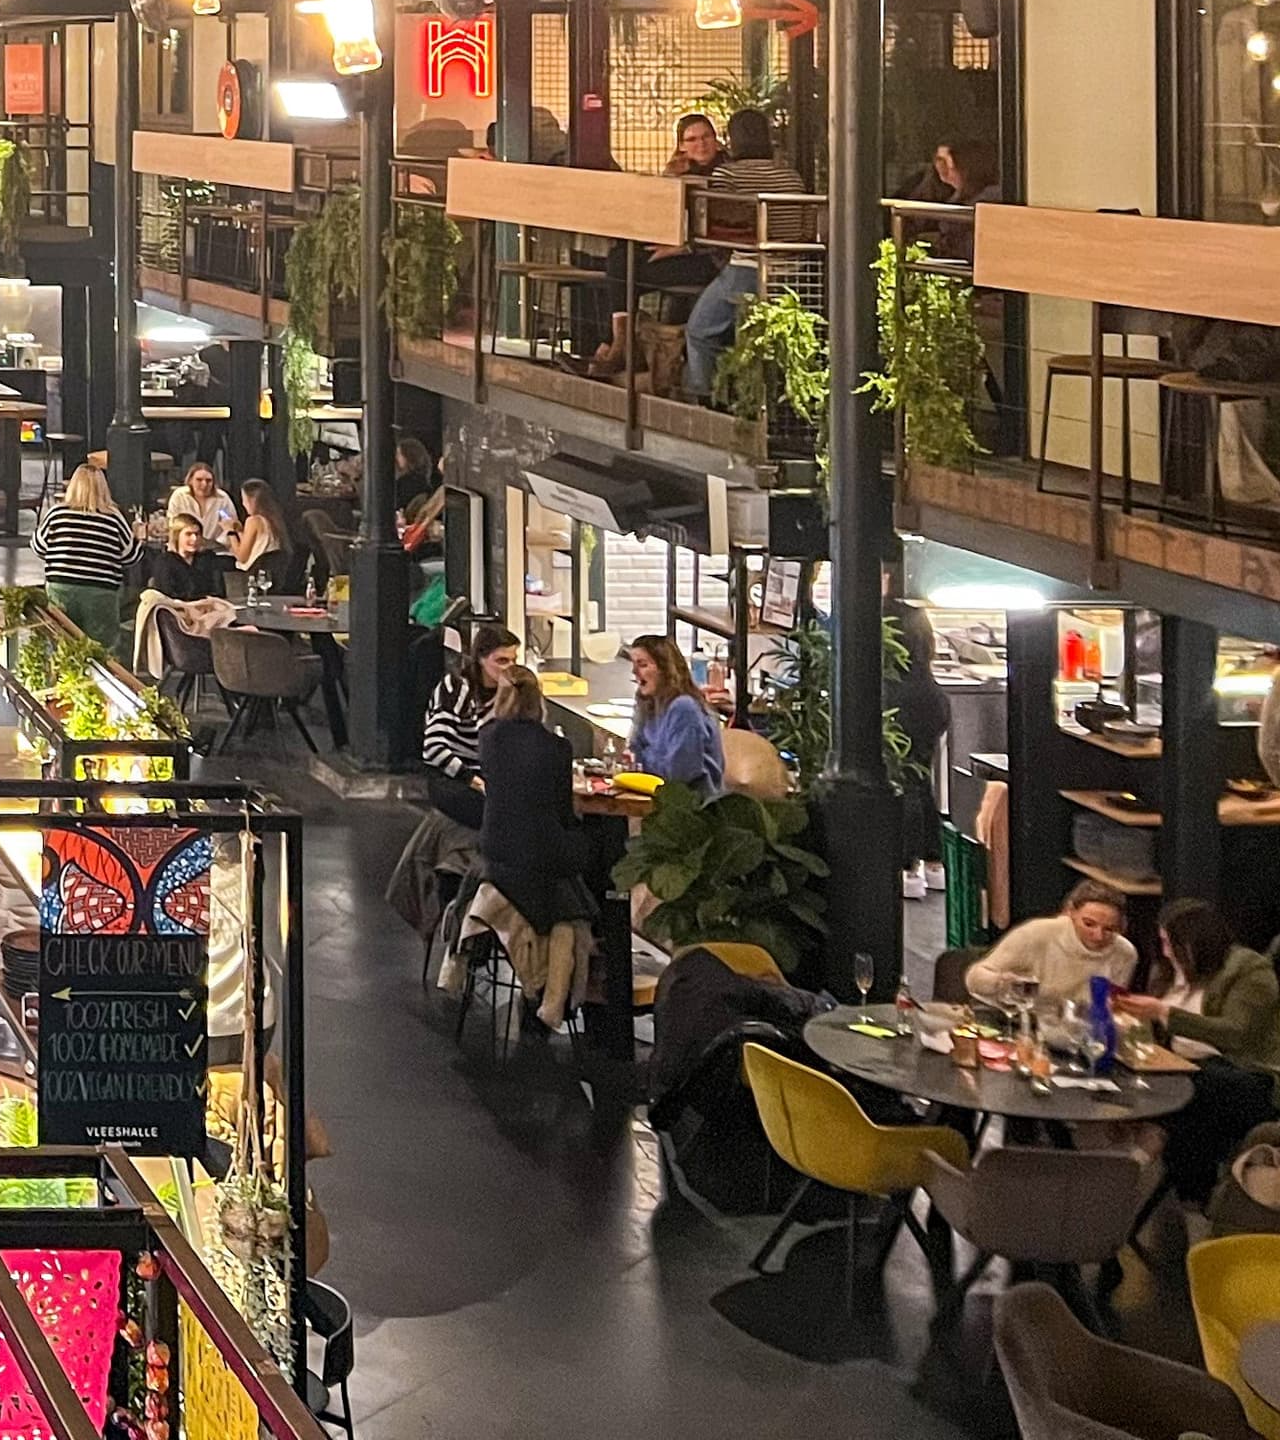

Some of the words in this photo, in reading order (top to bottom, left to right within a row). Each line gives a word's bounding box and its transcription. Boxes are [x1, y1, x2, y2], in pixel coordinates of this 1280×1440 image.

[45, 938, 111, 976] CHECK
[117, 939, 147, 977] OUR
[110, 1000, 168, 1030] FRESH
[47, 1032, 96, 1063] 100%
[86, 1126, 159, 1138] VLEESHALLE
